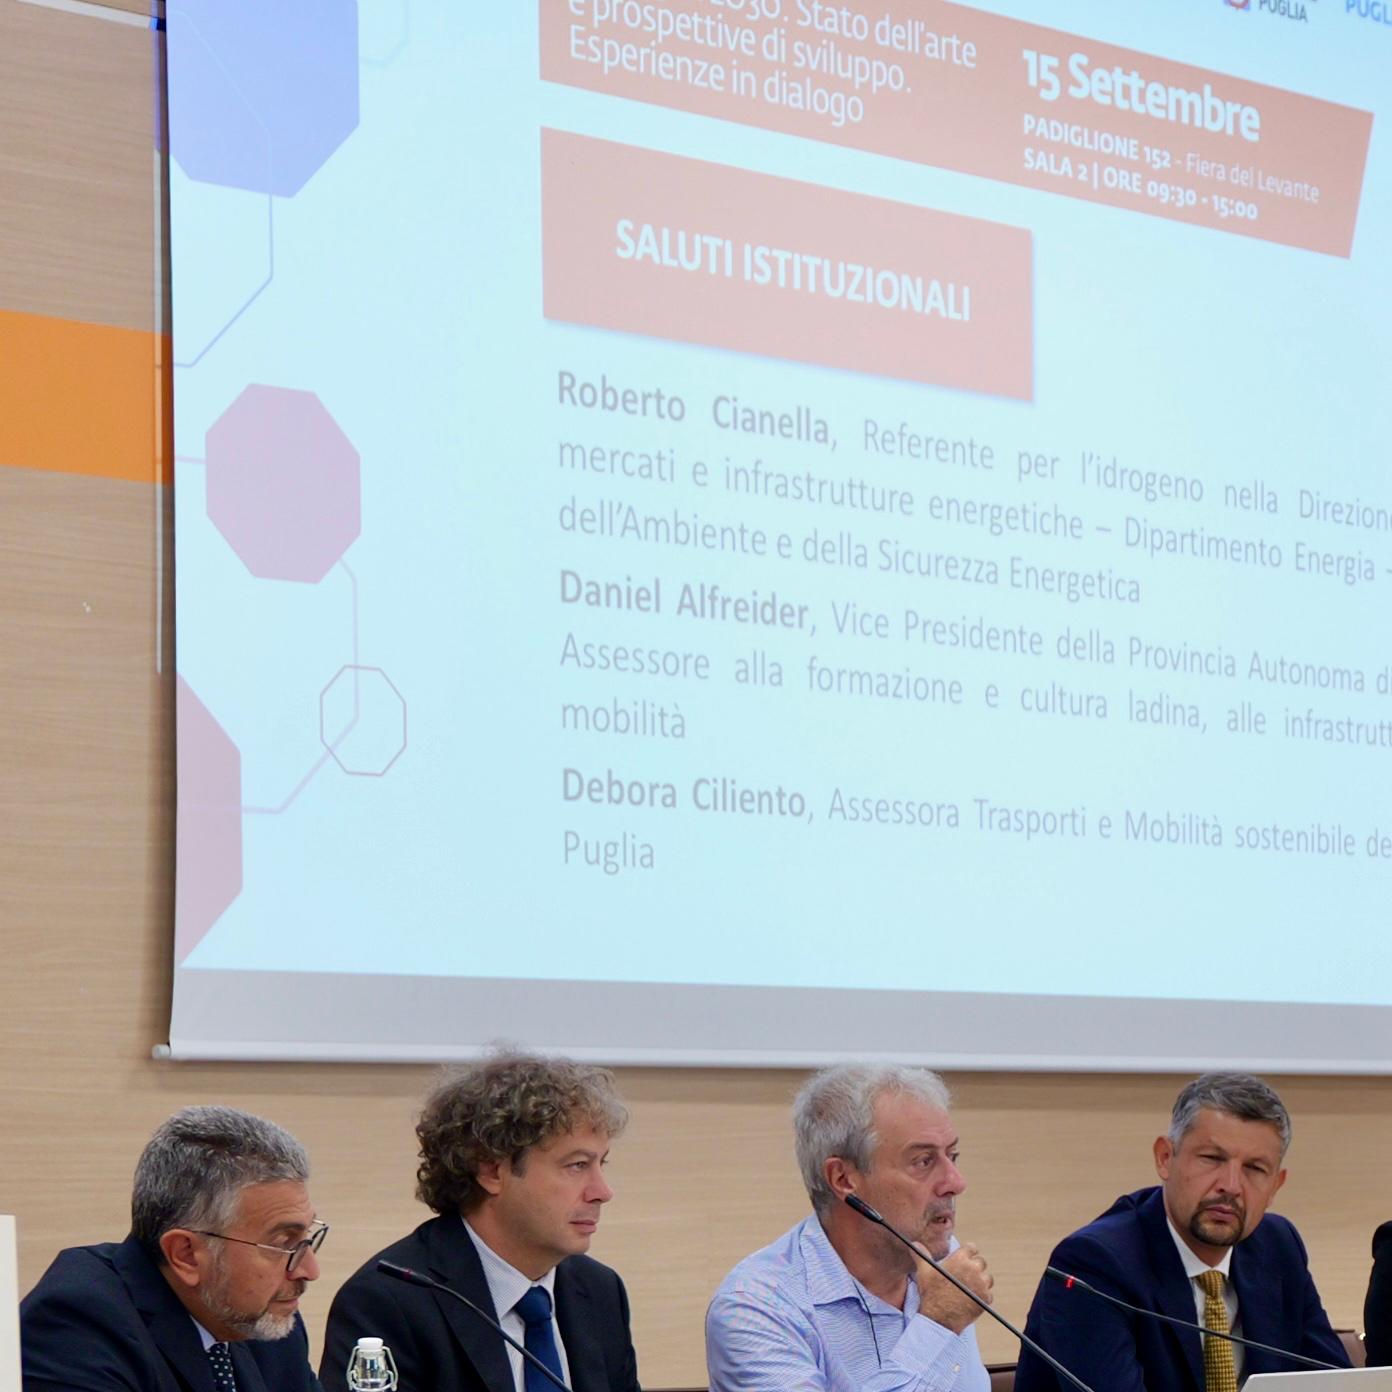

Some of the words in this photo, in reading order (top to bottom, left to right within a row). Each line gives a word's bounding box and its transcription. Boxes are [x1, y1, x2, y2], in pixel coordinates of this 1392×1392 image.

[593, 0, 756, 56] prospettive
[763, 27, 786, 63] di
[794, 40, 911, 94] sviluppo.
[797, 0, 868, 40] Stato
[876, 14, 977, 68] dell'arte
[1259, 0, 1308, 22] PUGLIA
[570, 24, 724, 92] Esperienze
[731, 59, 756, 98] in
[764, 68, 864, 128] dialogo
[1022, 50, 1060, 101] 15
[1068, 53, 1260, 142] Settembre
[1024, 114, 1139, 161] PADIGLIONE
[1144, 146, 1171, 169] 152
[1187, 153, 1226, 182] Fiera
[1230, 162, 1254, 187] del
[1258, 170, 1320, 203] Levante
[1024, 148, 1072, 177] SALA
[1078, 164, 1088, 181] 2
[1103, 166, 1141, 193] ORE
[1147, 180, 1196, 208] 09:30
[1212, 195, 1258, 220] 15:00
[616, 219, 733, 278] SALUTI
[744, 243, 971, 322] ISTITUZIONALI
[558, 371, 686, 422] Roberto
[712, 396, 838, 450] Cianella,
[864, 419, 994, 469] Referente
[1017, 449, 1060, 483] per
[1224, 480, 1278, 514] nella
[558, 439, 675, 483] mercati
[692, 461, 708, 488] e
[725, 457, 915, 515] infrastrutture
[928, 491, 1083, 540] energetiche
[1125, 516, 1282, 567] Dipartimento
[1294, 541, 1375, 586] Energia
[776, 530, 792, 559] e
[803, 528, 868, 569] della
[879, 538, 998, 585] Sicurezza
[1010, 556, 1141, 604] Energetica
[561, 569, 661, 613] Daniel
[677, 583, 818, 634] Alfreider,
[831, 600, 889, 638] Vice
[904, 609, 1043, 656] Presidente
[1056, 626, 1115, 664] della
[1129, 635, 1236, 677] Provincia
[1248, 650, 1365, 693] Autonoma
[560, 632, 710, 680] Assessore
[734, 651, 784, 687] alla
[807, 655, 963, 704] formazione
[985, 683, 999, 708] e
[1020, 680, 1108, 719] cultura
[1129, 691, 1208, 734] ladina,
[1226, 700, 1266, 734] alle
[562, 697, 686, 740] mobilità
[563, 768, 677, 809] Debora
[692, 777, 814, 824] Ciliento,
[828, 787, 959, 827] Assessora
[973, 797, 1086, 840] Trasporti
[1098, 812, 1112, 838] e
[1124, 810, 1222, 846] Mobilità
[1235, 822, 1356, 856] sostenibile
[563, 830, 655, 875] Puglia
